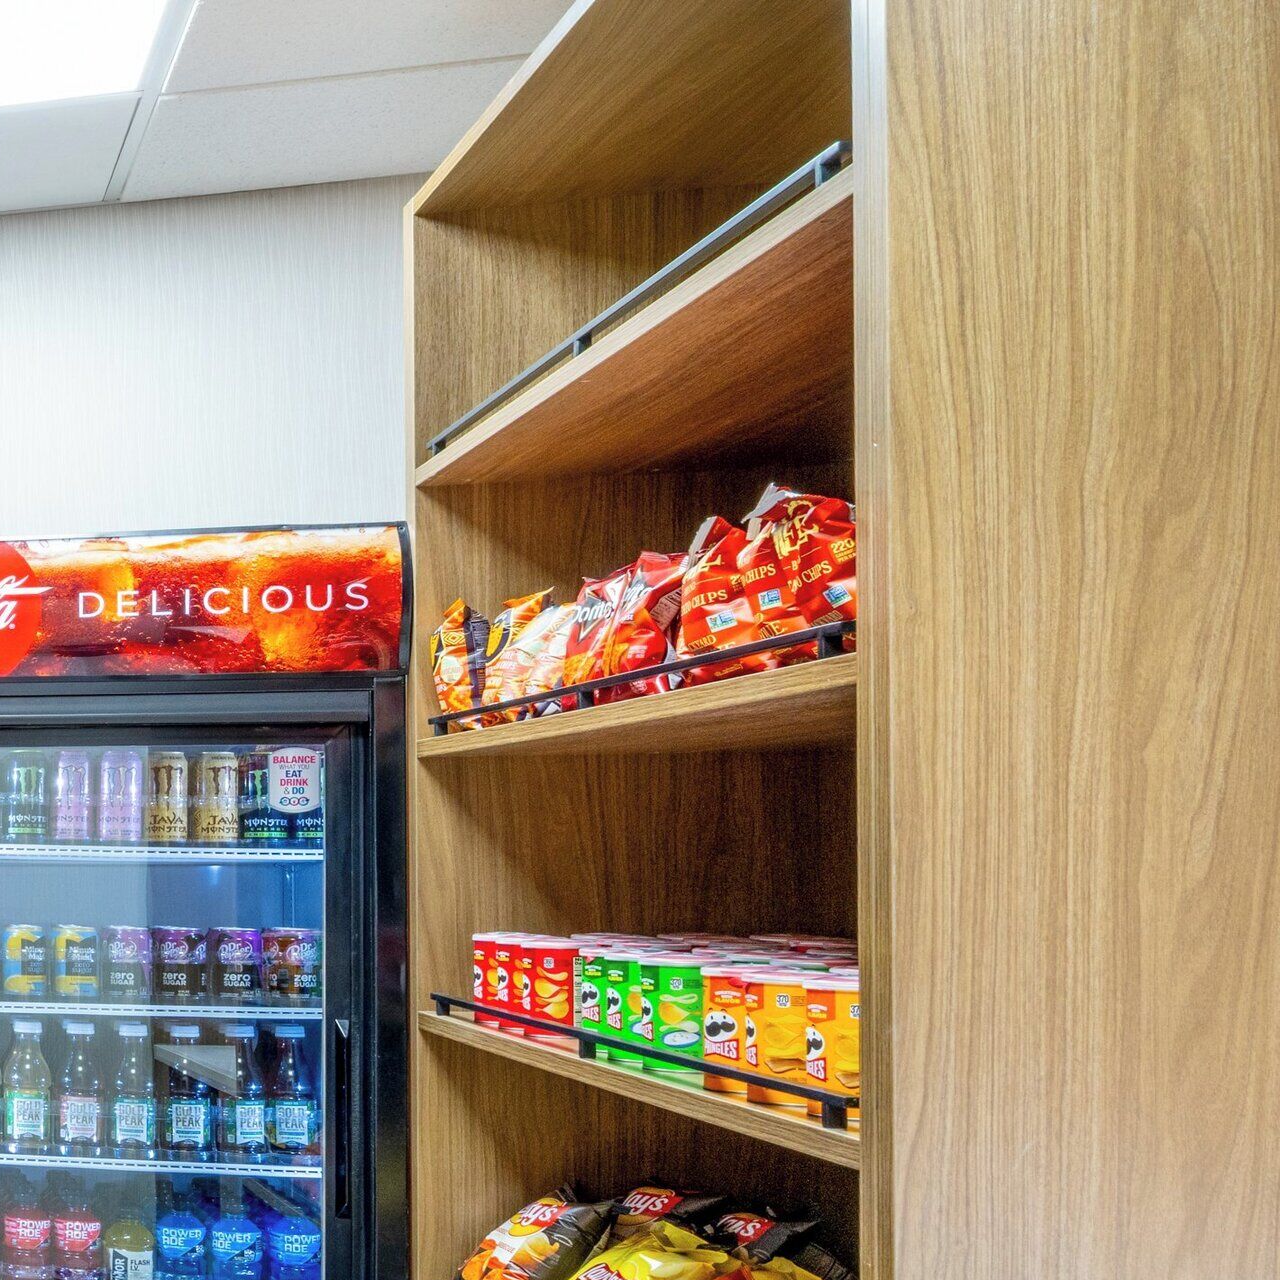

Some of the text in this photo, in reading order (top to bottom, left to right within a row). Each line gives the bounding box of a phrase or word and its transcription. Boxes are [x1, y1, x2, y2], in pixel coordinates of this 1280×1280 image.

[801, 560, 832, 584] CHIPS
[77, 581, 371, 619] DELICIOUS
[272, 756, 315, 764] BALANCE
[286, 770, 302, 778] EAT
[280, 778, 308, 786] DRINK
[150, 815, 183, 825] JAVA
[224, 973, 250, 982] zero
[776, 995, 788, 1003] 370
[70, 1114, 94, 1124] PEAK
[119, 1116, 144, 1126] PEAK
[176, 1117, 201, 1127] PEAK
[279, 1118, 305, 1127] PEAK
[19, 1220, 50, 1229] POWER
[66, 1221, 101, 1230] POWER
[162, 1228, 203, 1237] POWER
[212, 1231, 251, 1241] POWER
[162, 1237, 184, 1246] ADE
[212, 1240, 232, 1249] ADE
[284, 1244, 307, 1252] ADE
